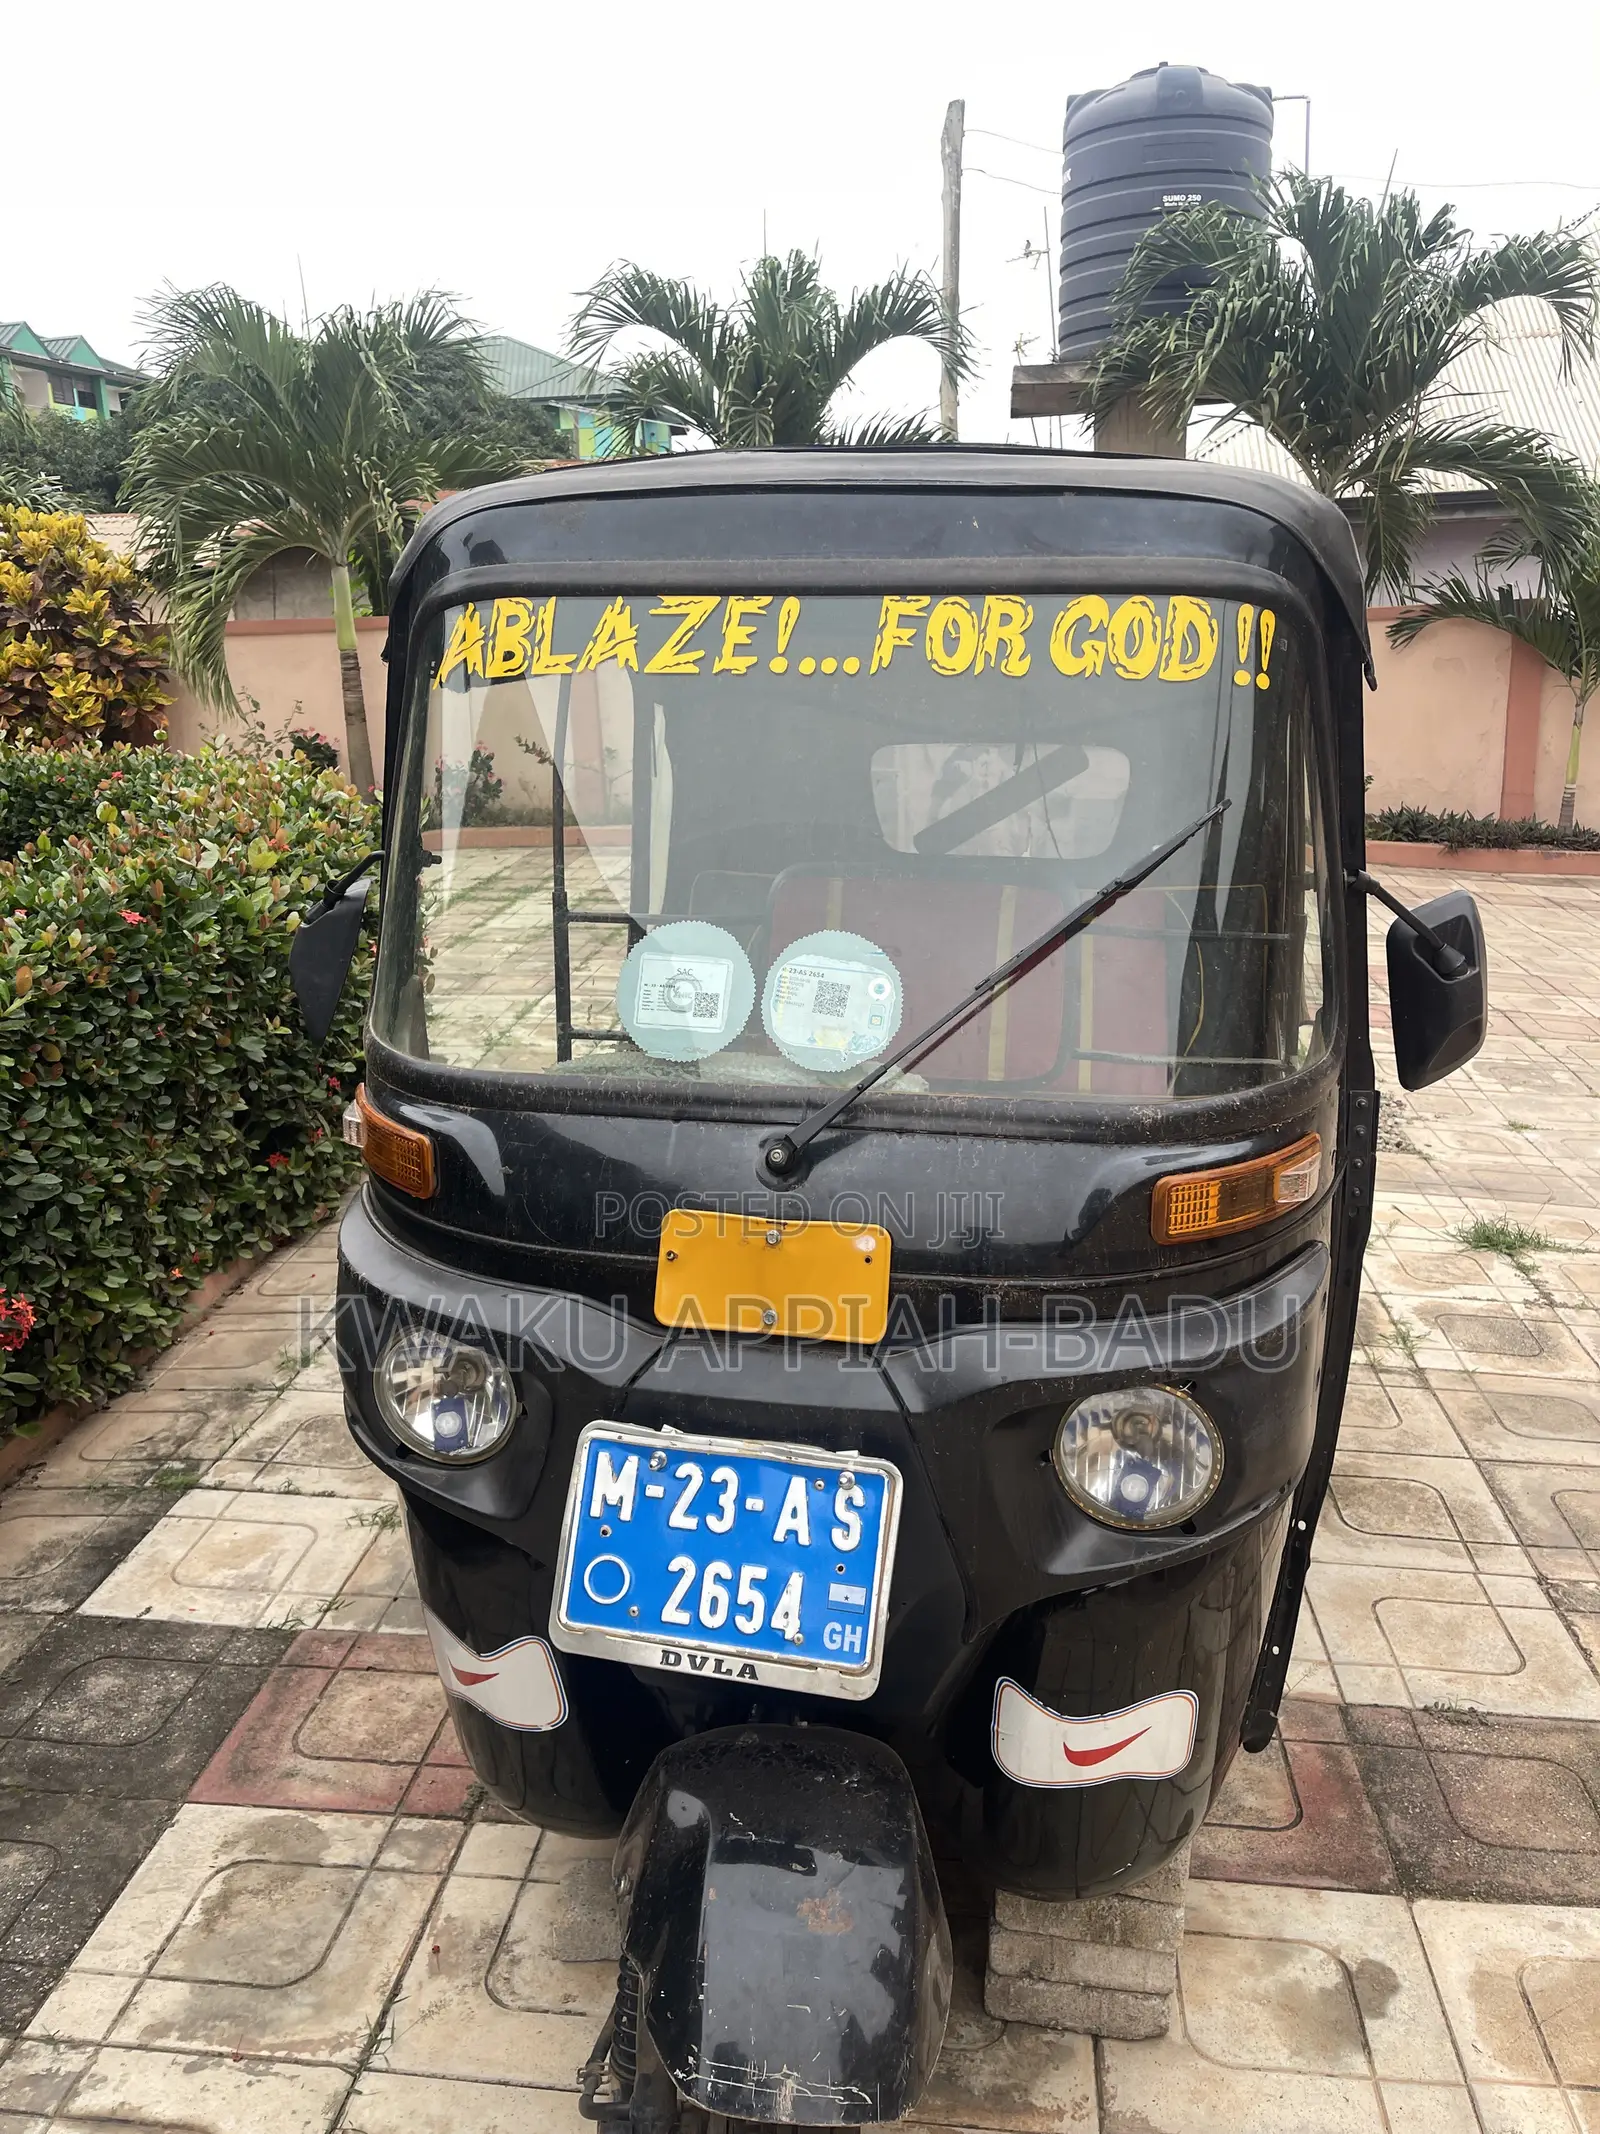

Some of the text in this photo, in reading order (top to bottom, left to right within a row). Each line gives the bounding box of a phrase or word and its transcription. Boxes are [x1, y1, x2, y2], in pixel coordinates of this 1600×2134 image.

[1162, 193, 1202, 203] SUMO 250
[870, 595, 1034, 678] FOR
[677, 967, 694, 976] SAC
[660, 1554, 804, 1641] 2654
[823, 1621, 863, 1653] GH
[659, 1649, 760, 1681] DVLA
